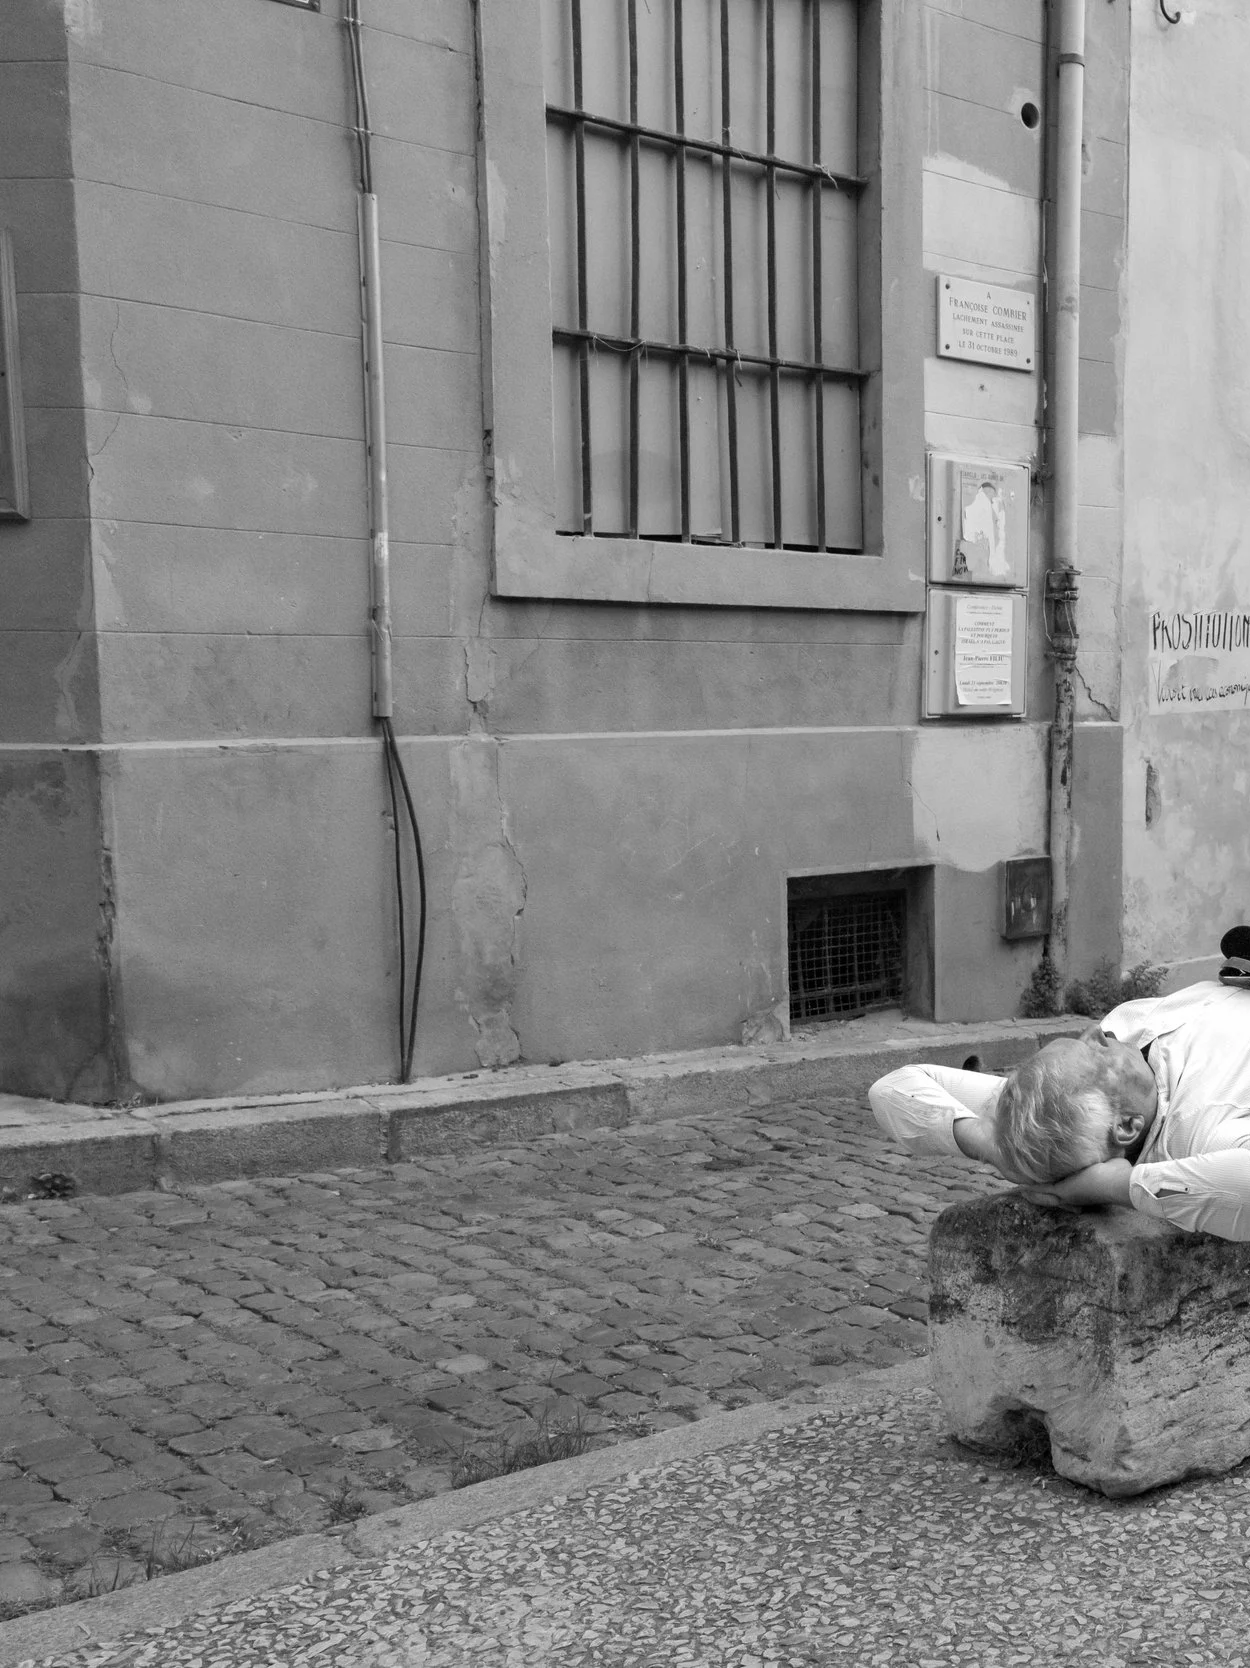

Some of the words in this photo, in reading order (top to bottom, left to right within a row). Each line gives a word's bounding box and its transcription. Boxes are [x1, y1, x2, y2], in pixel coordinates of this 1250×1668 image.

[949, 297, 988, 313] FRANÇOISE
[992, 305, 1027, 321] COMBIER
[962, 327, 974, 336] SUR
[975, 330, 994, 341] CETTE
[996, 334, 1014, 344] PLACE
[958, 340, 965, 348] LE
[967, 340, 975, 350] 31
[976, 343, 1002, 355] OCTOBRE
[1003, 347, 1018, 358] 1989
[1152, 611, 1250, 652] PROSTITUTION
